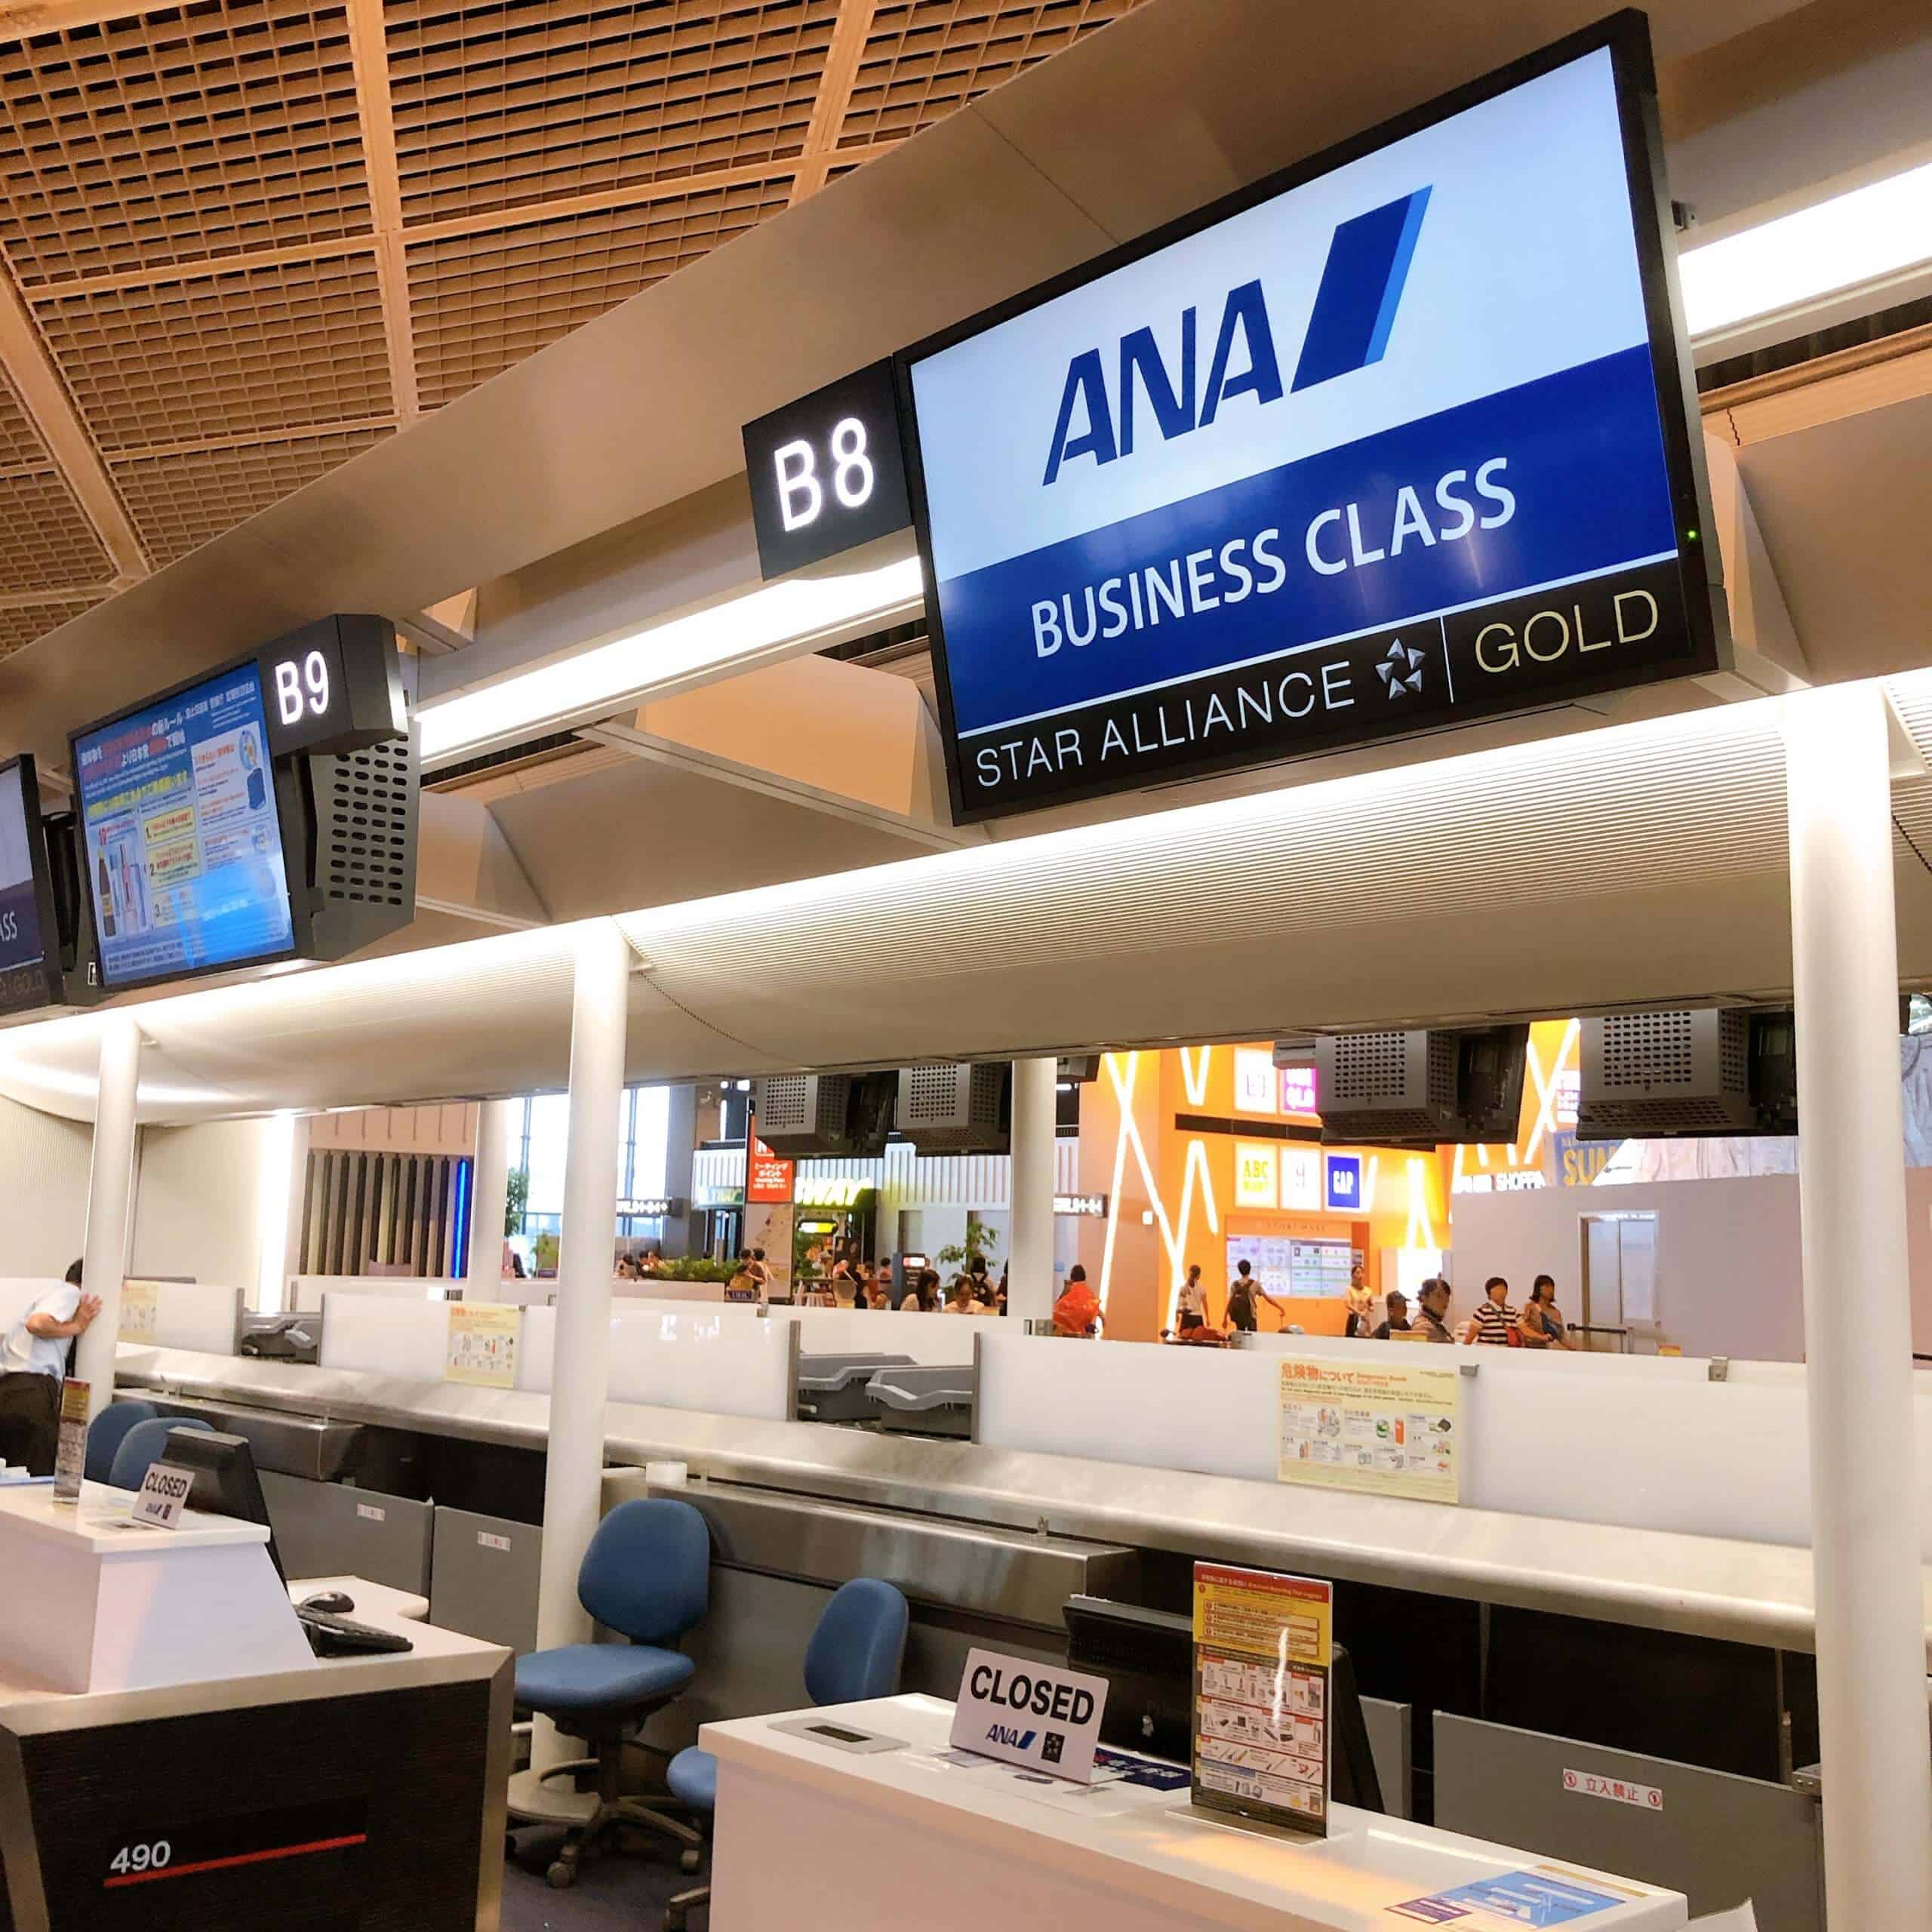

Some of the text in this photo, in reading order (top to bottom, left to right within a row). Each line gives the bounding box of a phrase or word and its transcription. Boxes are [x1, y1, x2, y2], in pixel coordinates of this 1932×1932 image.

[1042, 278, 1283, 486] ANA
[774, 417, 874, 532] B8
[1032, 457, 1515, 658] BUSINESS CLASS
[275, 651, 329, 724] B9
[977, 589, 1658, 786] STAR ALLIANCE GOLD
[1333, 1170, 1354, 1195] GAP
[146, 1472, 187, 1498] CLOSED
[971, 1666, 1094, 1724] CLOSED
[986, 1724, 1018, 1747] ANA
[1586, 1777, 1639, 1801] 立入禁止
[110, 1841, 171, 1874] 490
